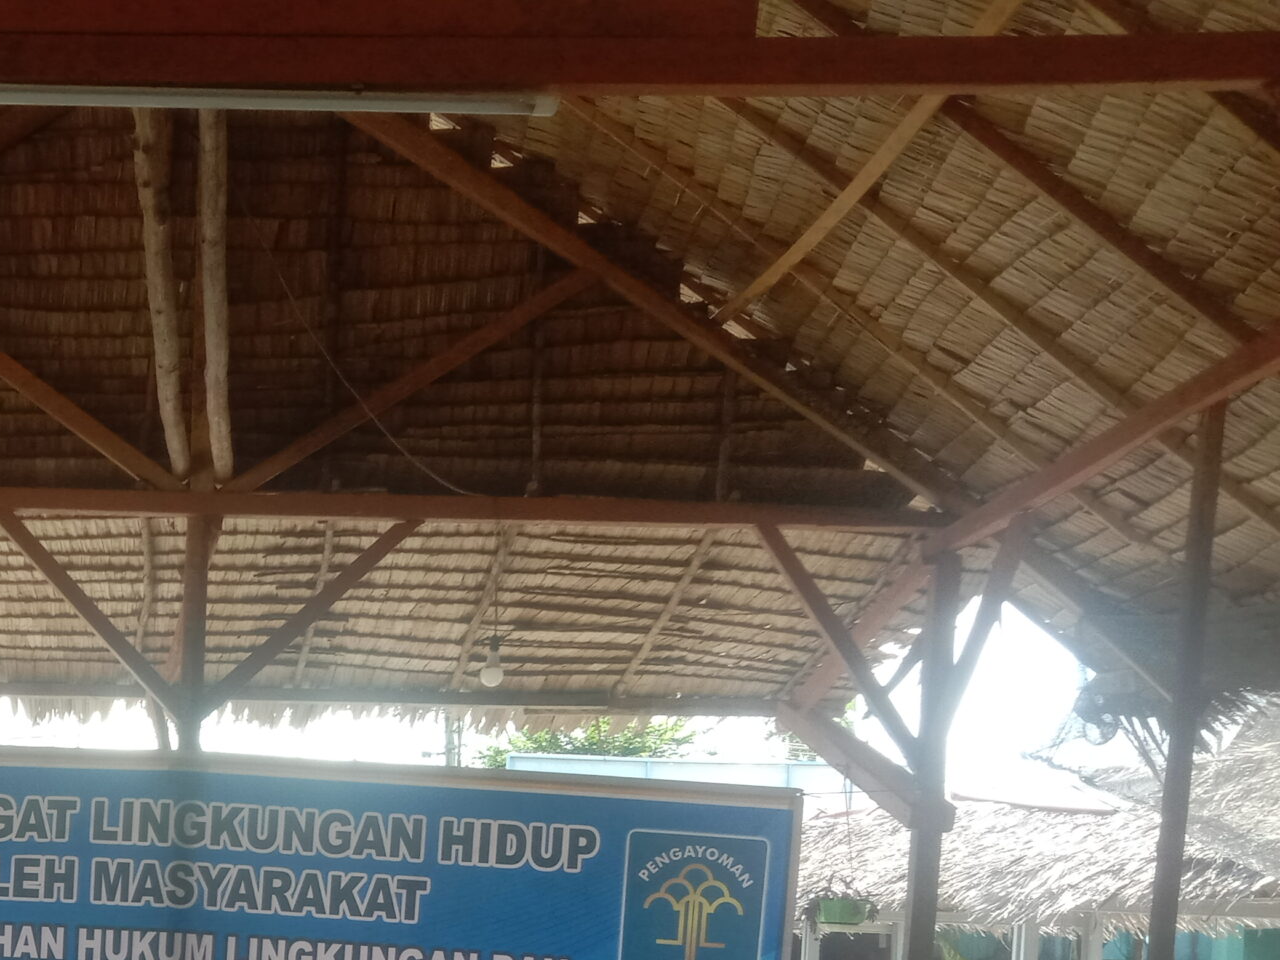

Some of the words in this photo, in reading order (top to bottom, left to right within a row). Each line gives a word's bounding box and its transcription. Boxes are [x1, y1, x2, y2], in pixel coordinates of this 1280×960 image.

[90, 798, 427, 863] LINGKUNGAN
[438, 816, 600, 873] HIDUP
[638, 845, 754, 889] PENGAYOMAN
[91, 858, 431, 924] MASYARAKAT
